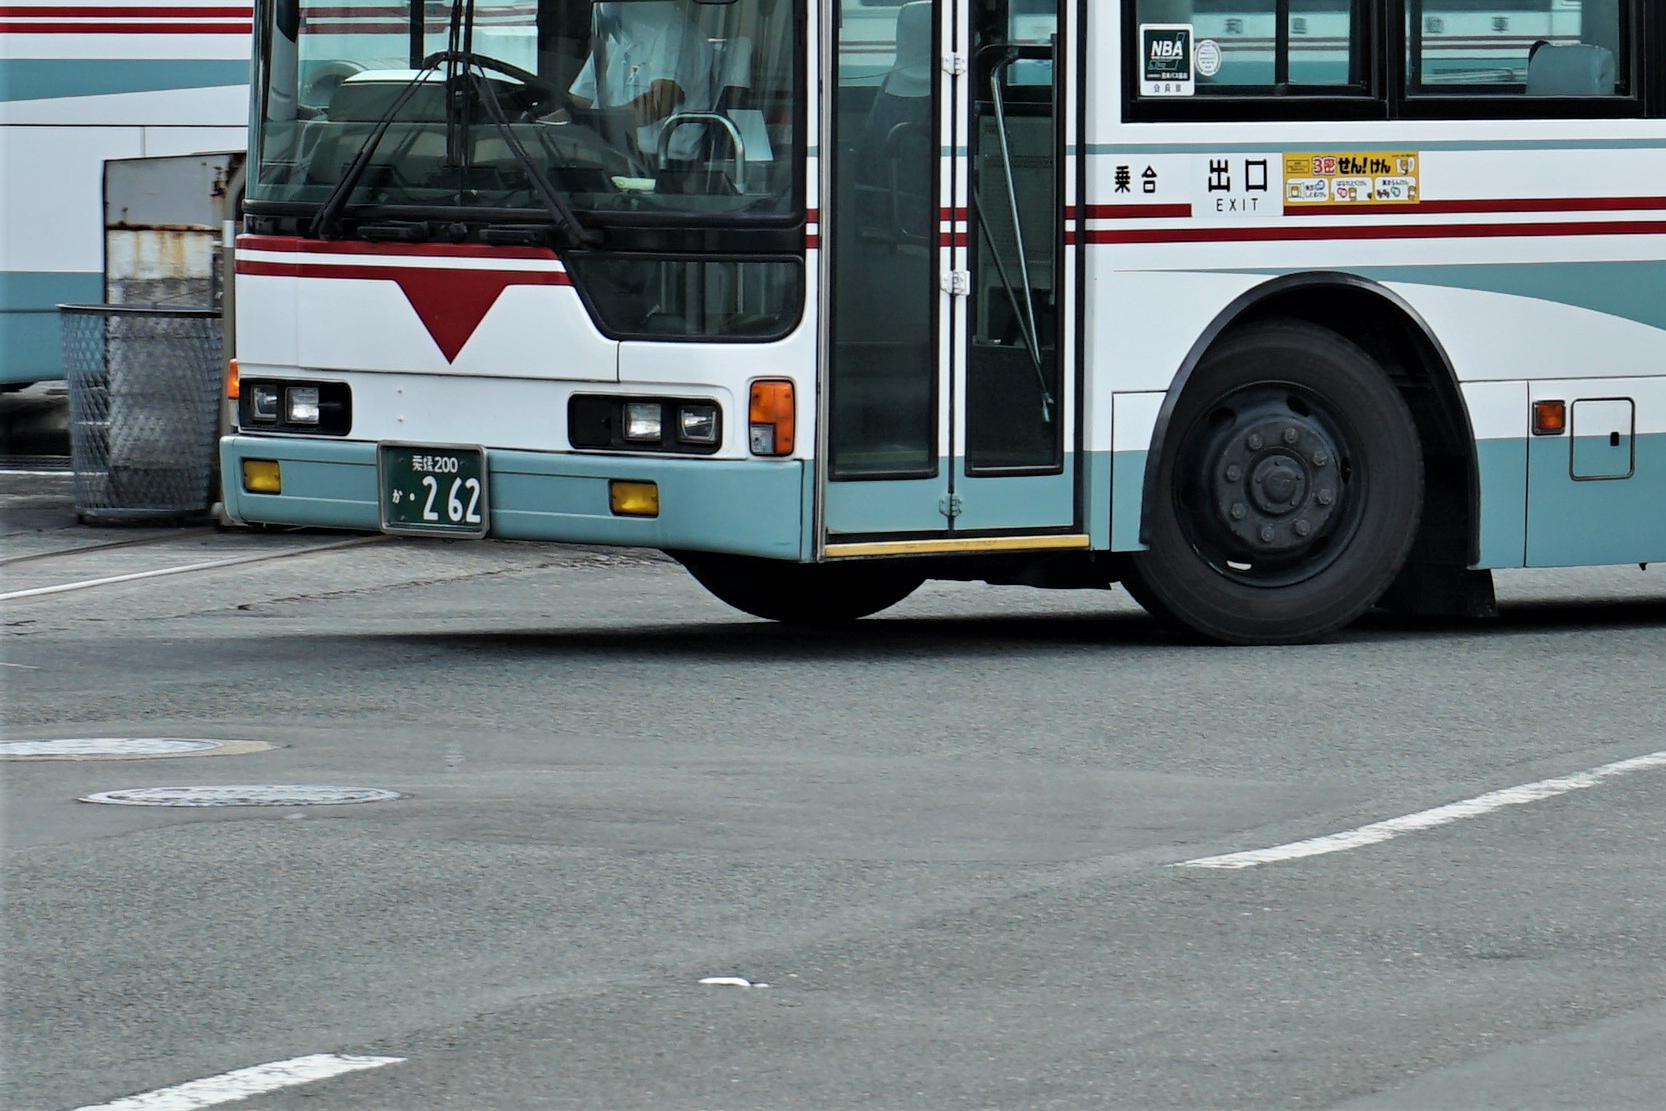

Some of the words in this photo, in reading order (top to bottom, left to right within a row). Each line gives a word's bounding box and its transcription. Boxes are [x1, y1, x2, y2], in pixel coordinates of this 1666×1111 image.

[1151, 40, 1184, 57] NBA
[1114, 165, 1158, 194] 乗合
[1207, 158, 1268, 193] 出口
[1216, 197, 1259, 212] EXIT
